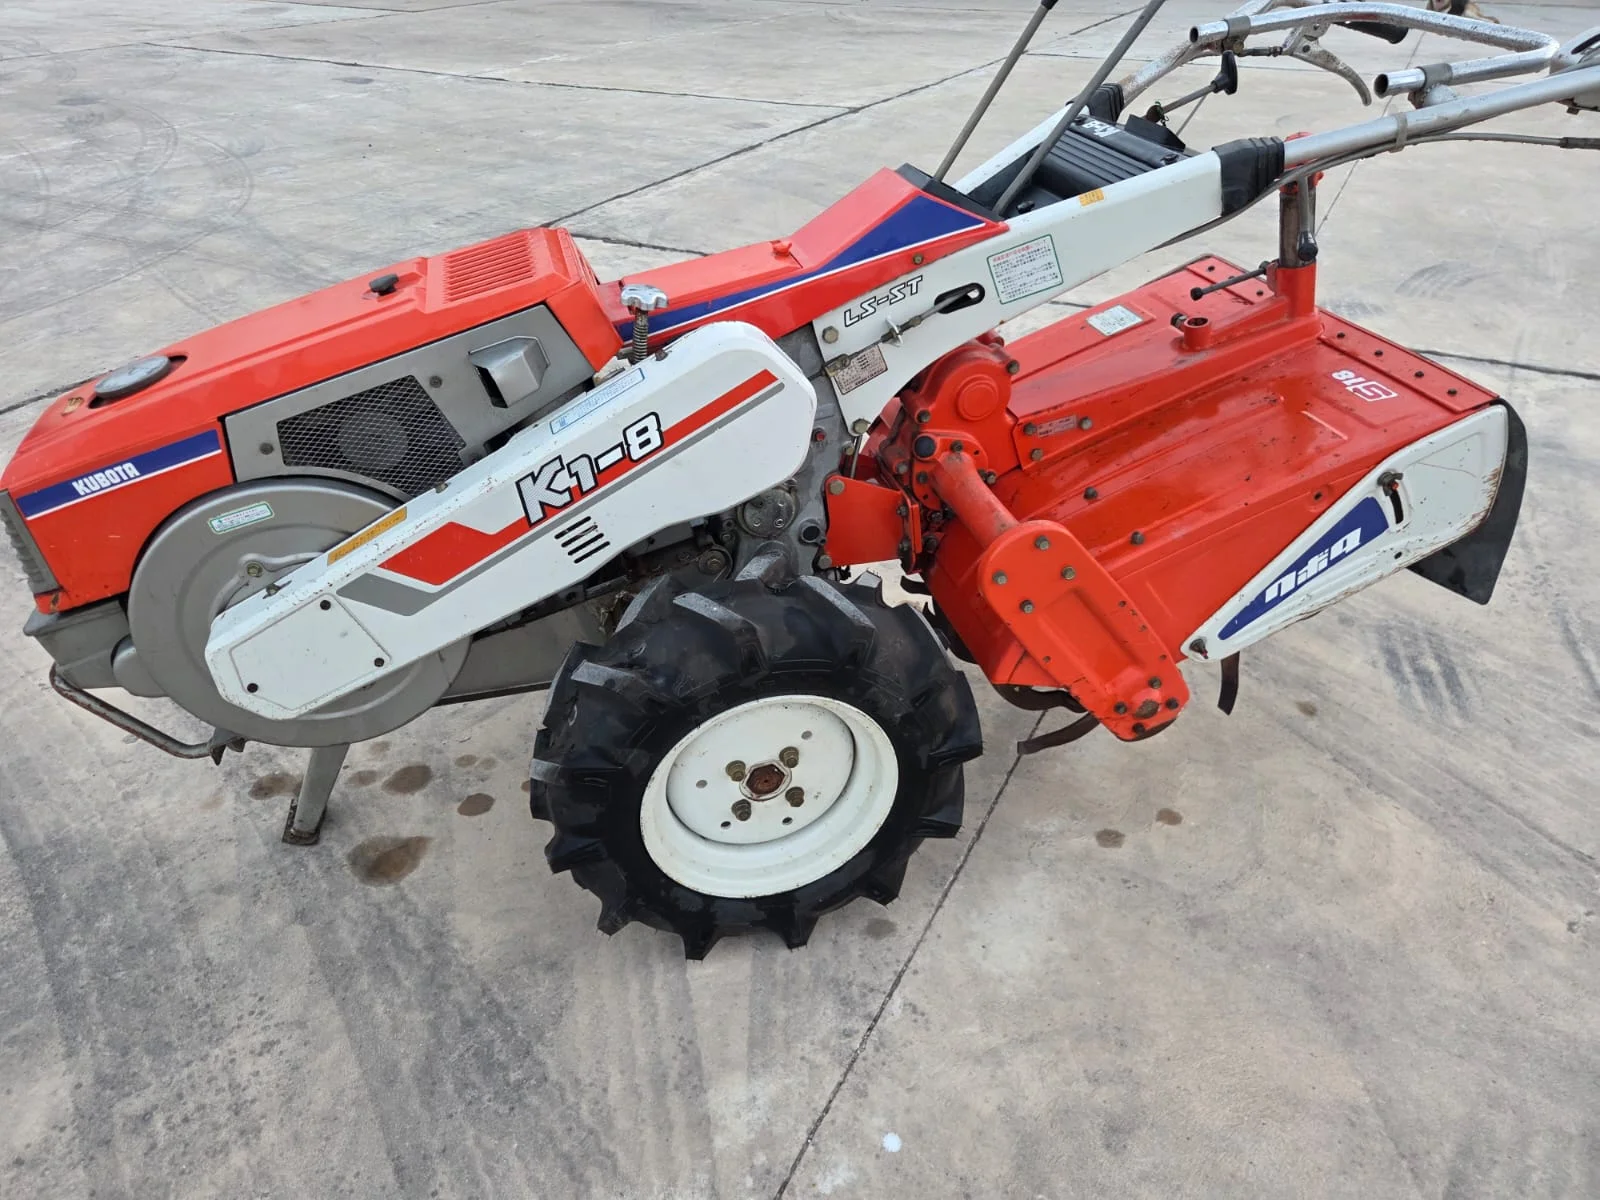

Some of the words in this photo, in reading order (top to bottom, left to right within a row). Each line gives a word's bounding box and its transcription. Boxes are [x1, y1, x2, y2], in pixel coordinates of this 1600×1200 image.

[844, 275, 923, 328] LS-ST
[71, 462, 141, 496] KUBOTA
[515, 412, 664, 527] K1-8
